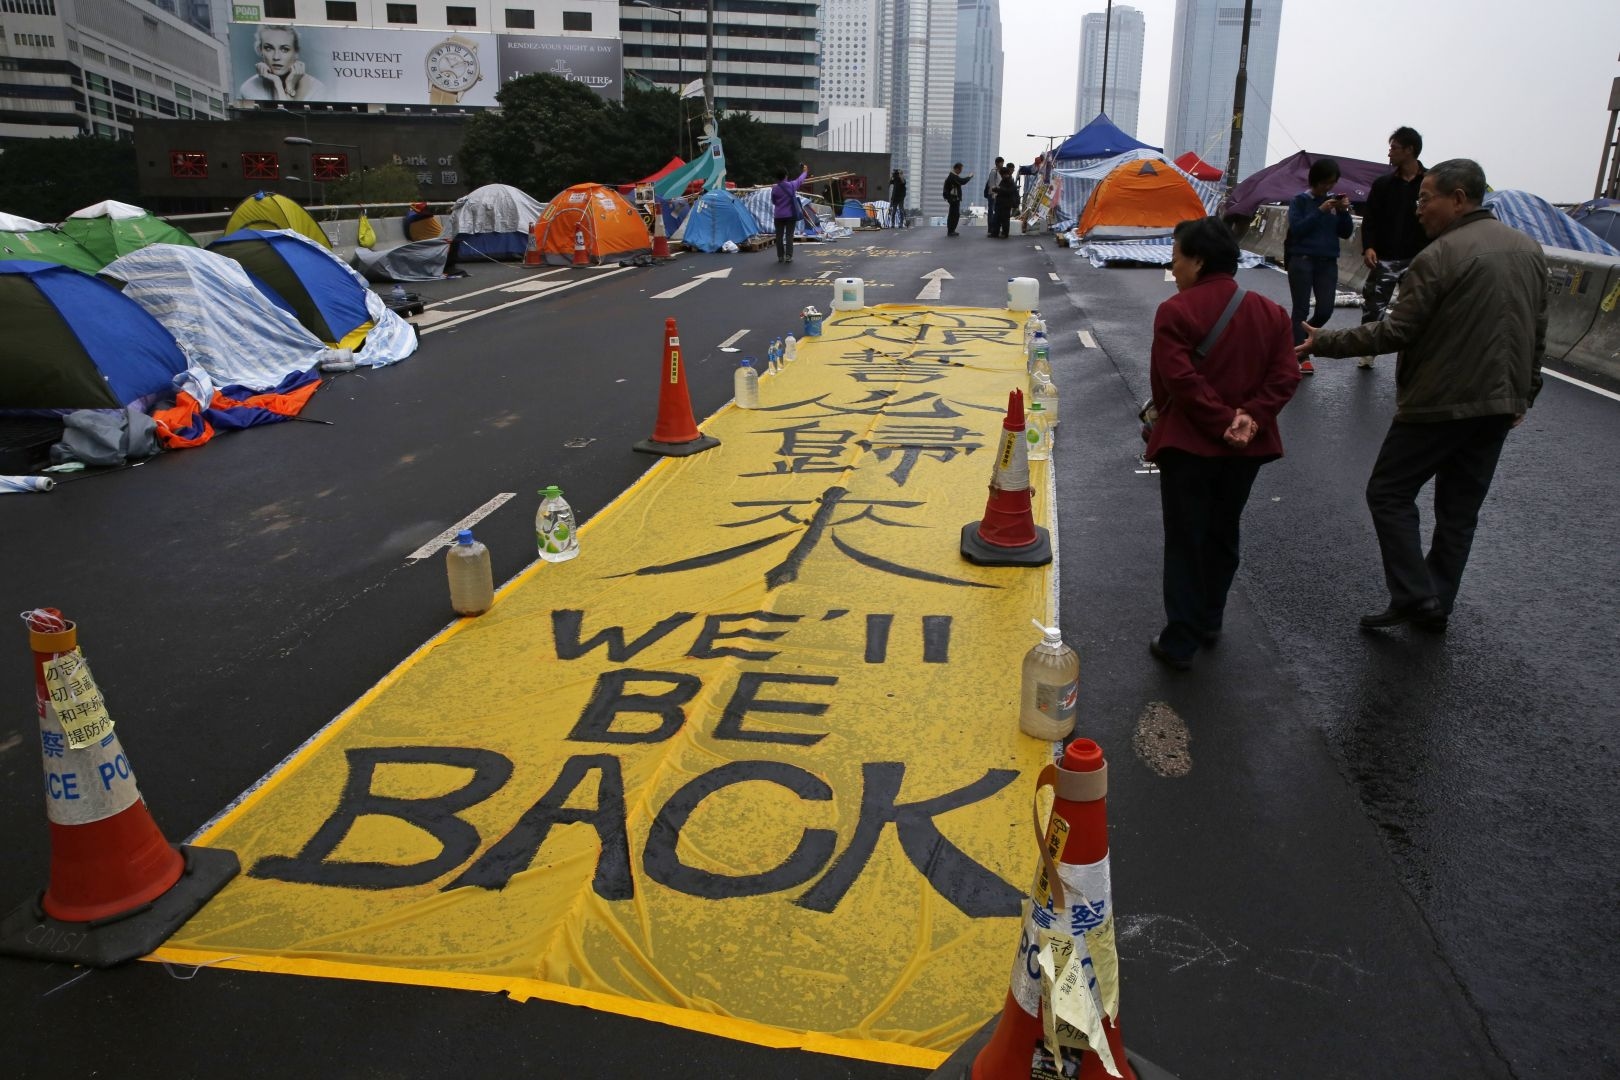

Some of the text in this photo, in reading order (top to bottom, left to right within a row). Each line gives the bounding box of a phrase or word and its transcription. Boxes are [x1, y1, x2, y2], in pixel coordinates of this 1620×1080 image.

[235, 6, 258, 16] POAD
[507, 42, 562, 50] RENDEZ-VOUS
[332, 51, 402, 63] REINVENT
[334, 67, 403, 79] YOURSELF
[438, 155, 453, 166] of
[565, 668, 840, 746] BE
[248, 746, 1028, 918] BACK
